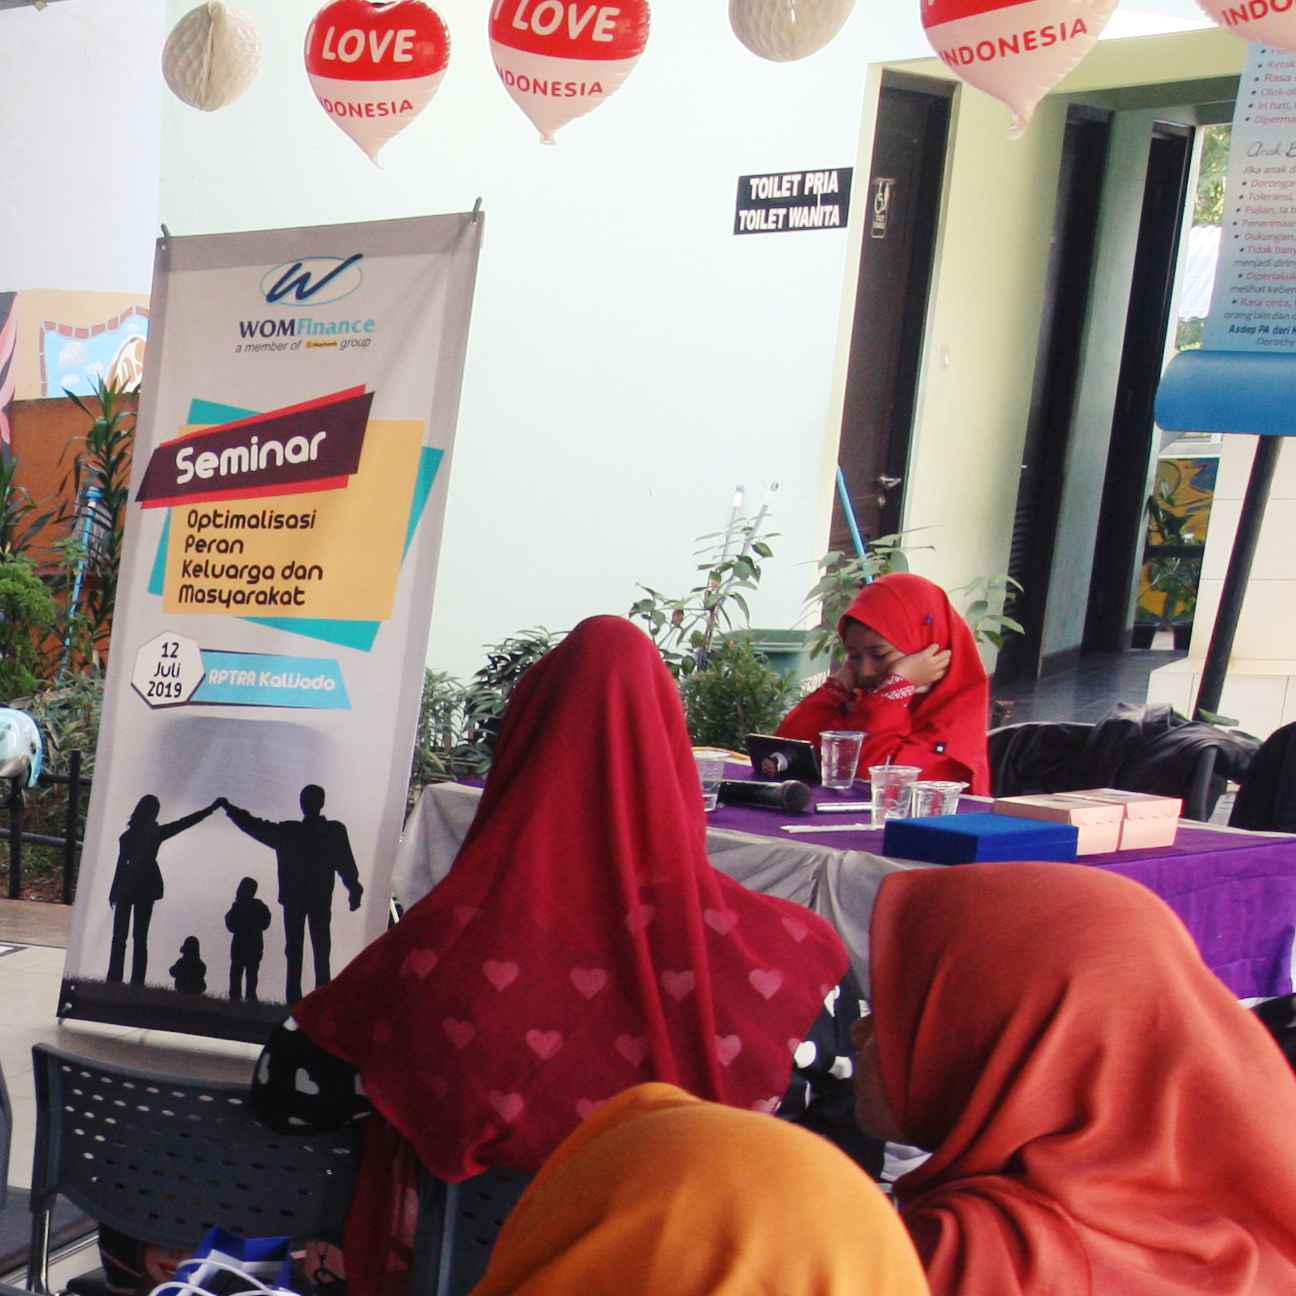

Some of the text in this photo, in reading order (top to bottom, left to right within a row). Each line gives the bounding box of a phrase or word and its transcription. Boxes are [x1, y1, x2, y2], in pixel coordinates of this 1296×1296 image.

[512, 0, 620, 42] LOVE
[322, 26, 417, 63] LOVE
[750, 170, 839, 200] TOILET PRIA
[739, 205, 840, 231] TOILET WANITA
[239, 318, 375, 338] WOMFinance
[244, 341, 288, 352] member
[290, 339, 303, 351] of
[339, 337, 371, 351] group
[176, 431, 327, 485] Seminar
[187, 509, 317, 533] Optimalisasi
[184, 534, 244, 554] Peran
[181, 559, 323, 584] Keluarga dan
[178, 584, 306, 608] Masyarakat
[161, 642, 179, 658] 12
[154, 661, 180, 678] Juli
[147, 681, 182, 698] 2019
